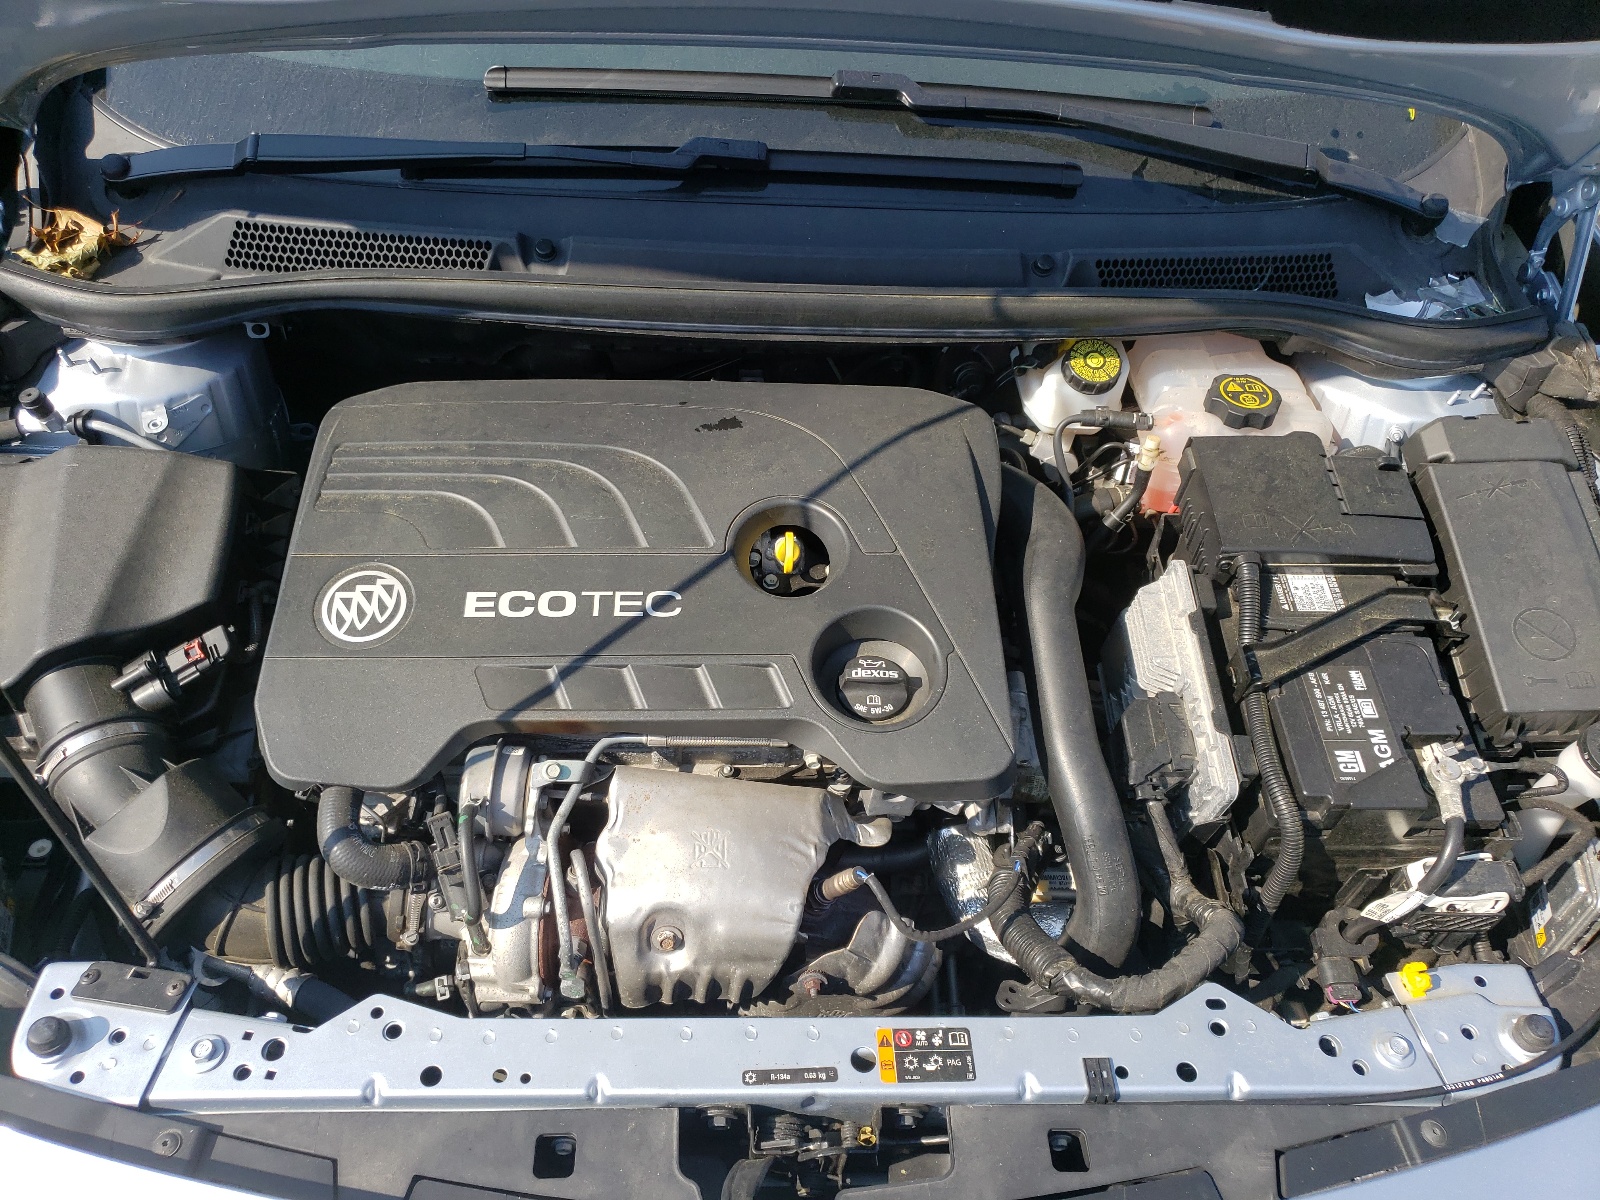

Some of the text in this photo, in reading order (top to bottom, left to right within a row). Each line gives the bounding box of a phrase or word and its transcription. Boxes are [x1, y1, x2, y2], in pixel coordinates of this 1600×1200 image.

[463, 590, 683, 618] ECOTEC
[851, 668, 899, 678] dexos
[854, 703, 894, 714] SAE 5W-30
[1327, 695, 1344, 731] VRLA AGM
[1334, 750, 1364, 773] GM
[946, 1058, 962, 1066] PAG
[818, 1071, 826, 1080] kg
